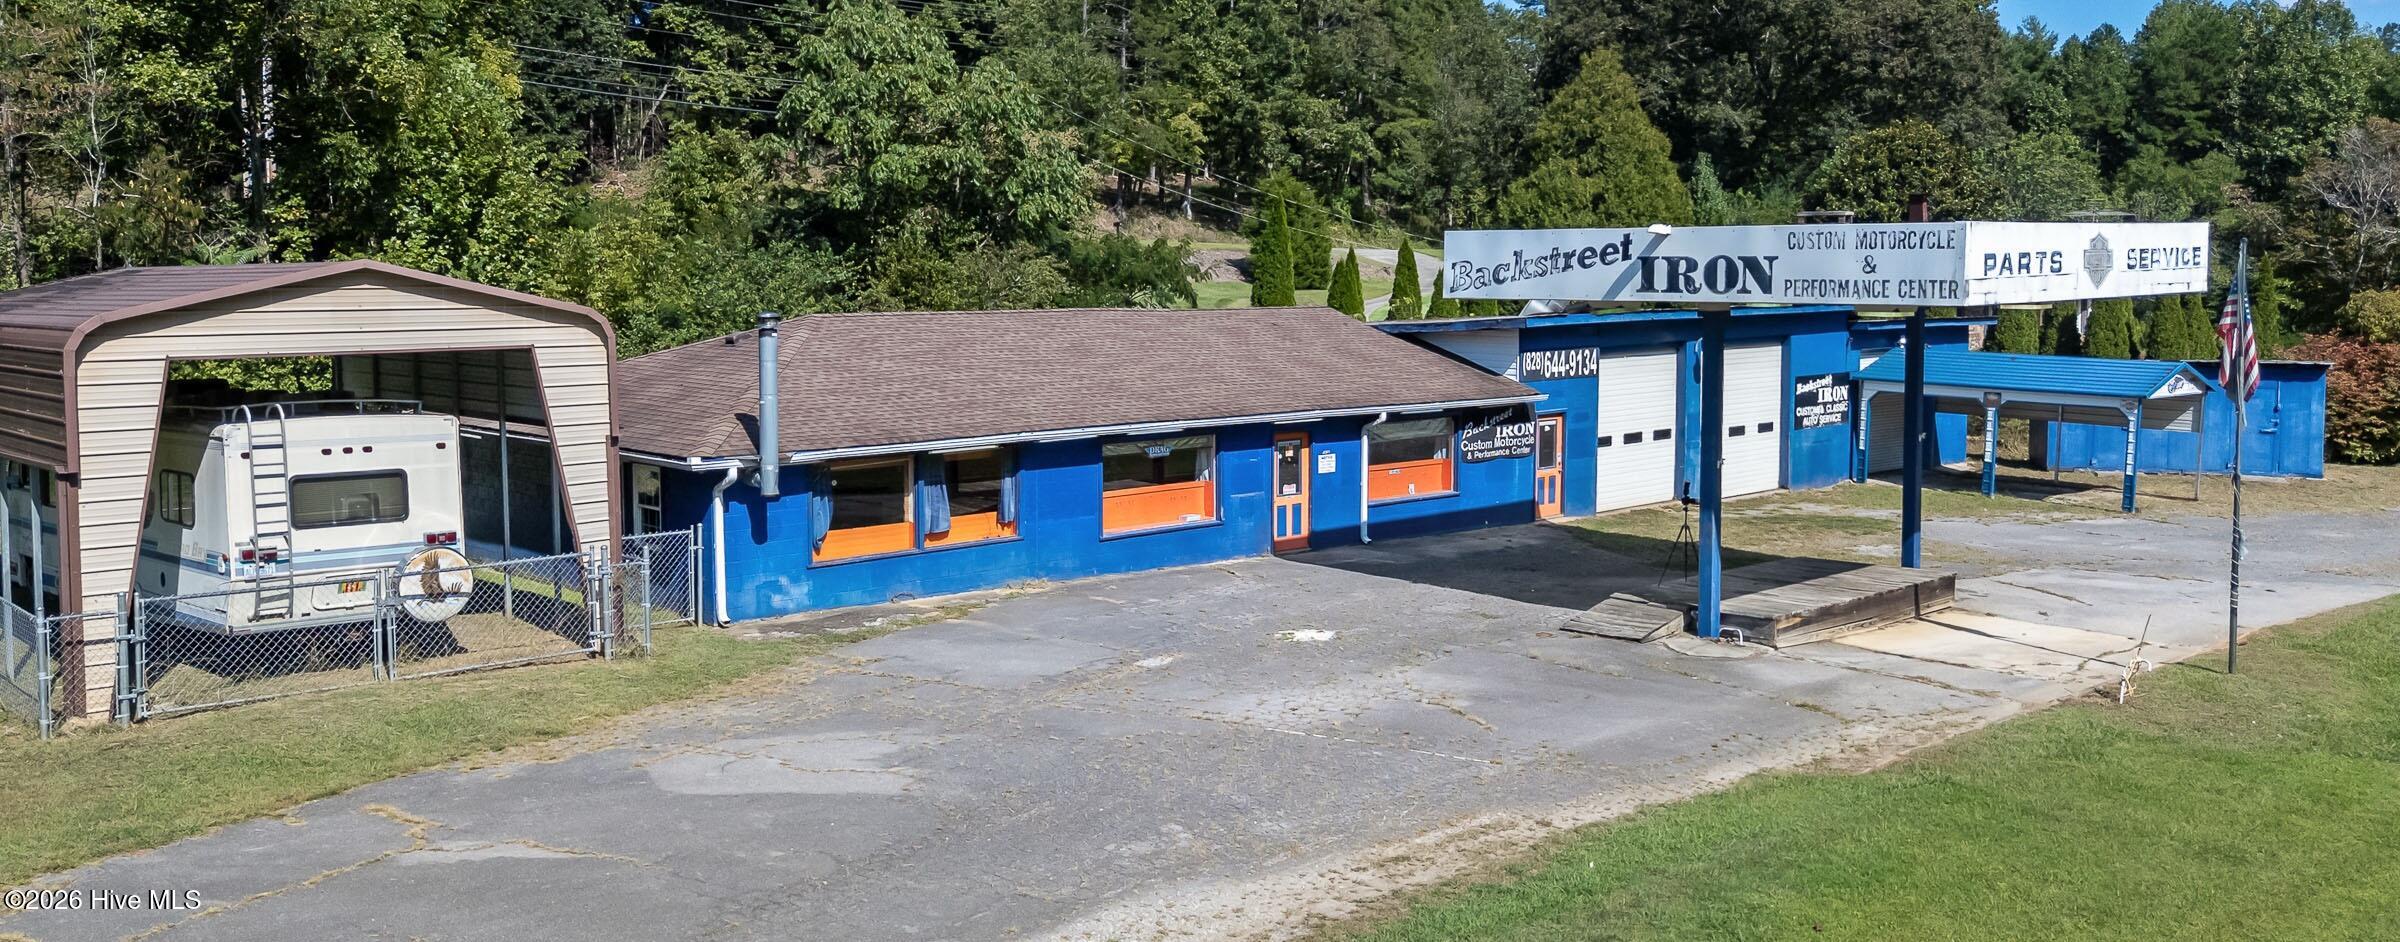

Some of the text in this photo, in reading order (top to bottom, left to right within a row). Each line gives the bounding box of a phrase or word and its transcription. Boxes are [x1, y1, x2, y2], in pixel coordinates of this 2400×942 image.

[1787, 229, 1956, 250] CUSTOM MOTORCYCLE
[1450, 232, 1779, 295] Backstreet IRON
[1861, 254, 1877, 275] &
[1983, 250, 2063, 277] PARTS
[2127, 246, 2201, 270] SERVICE
[1783, 278, 1960, 300] PERFORMANCE CENTER
[1817, 385, 1849, 403] IRON
[1495, 421, 1536, 438] IRON
[1460, 435, 1535, 451] Custom Motorcycle
[1474, 448, 1510, 459] Performance
[1511, 446, 1531, 455] Center
